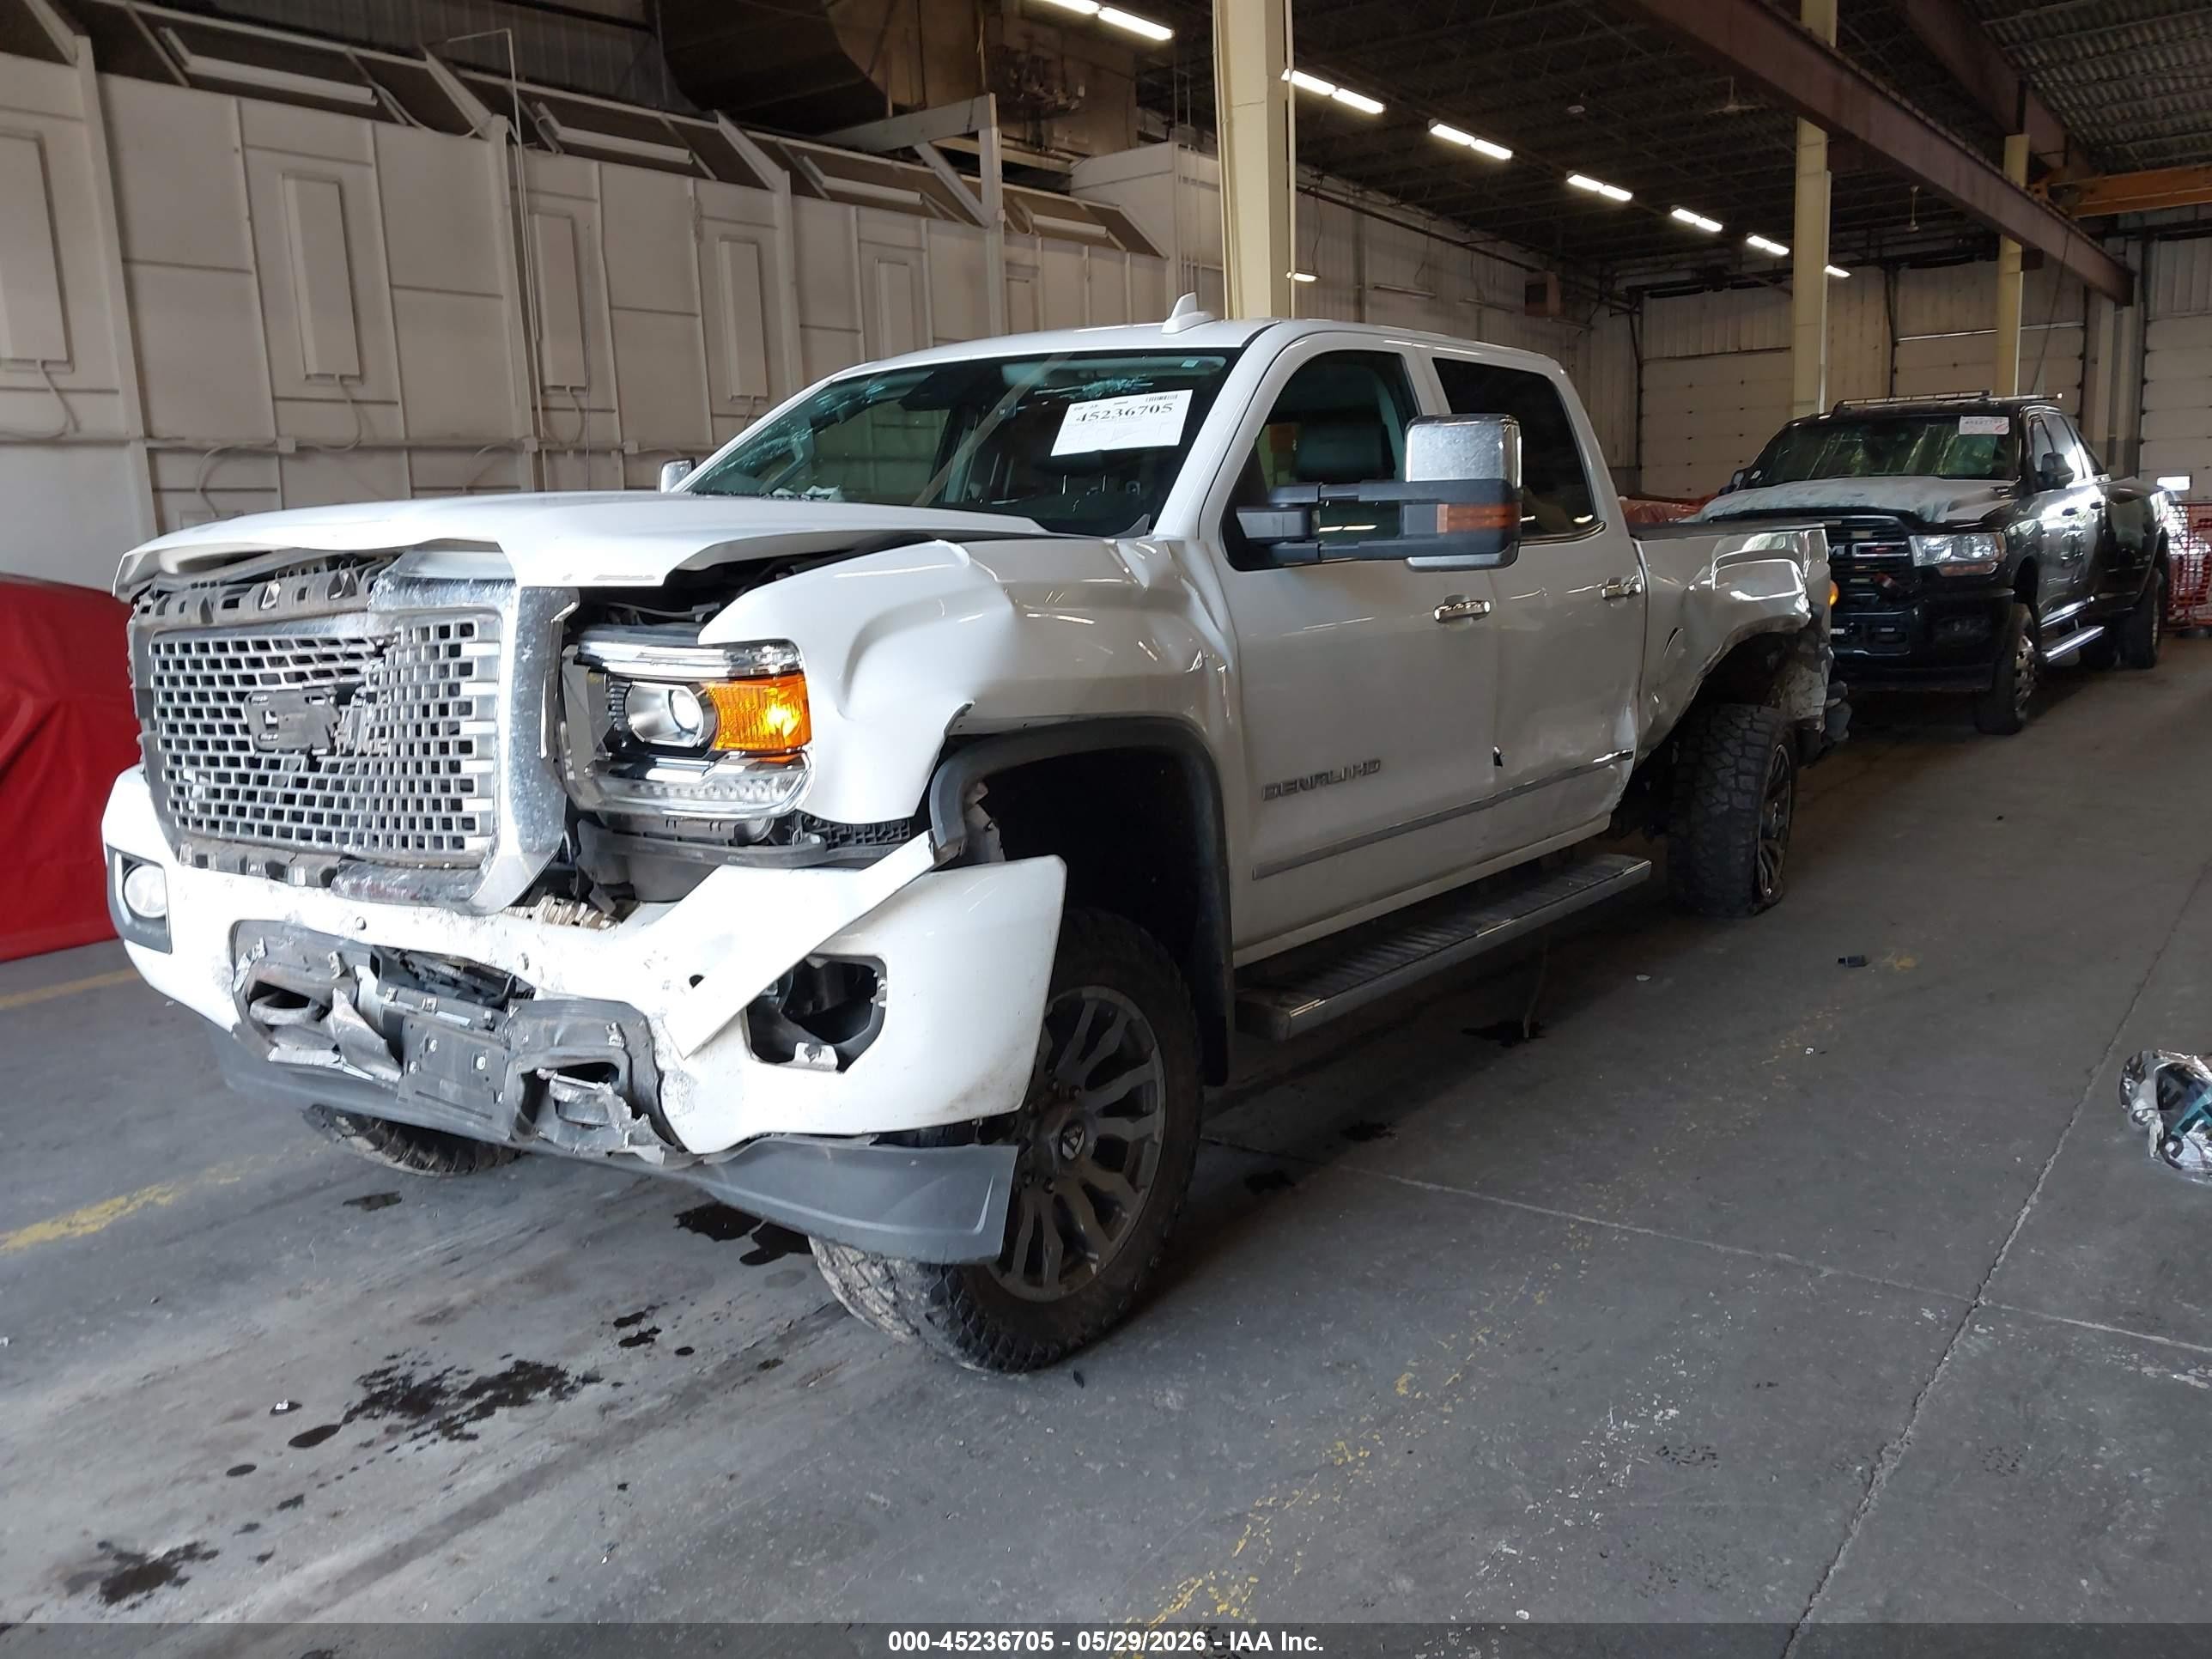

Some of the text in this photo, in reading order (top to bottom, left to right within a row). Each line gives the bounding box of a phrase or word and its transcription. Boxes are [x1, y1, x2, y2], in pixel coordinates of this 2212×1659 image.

[1075, 403, 1174, 422] 45236705
[1261, 759, 1382, 801] DENALI HD
